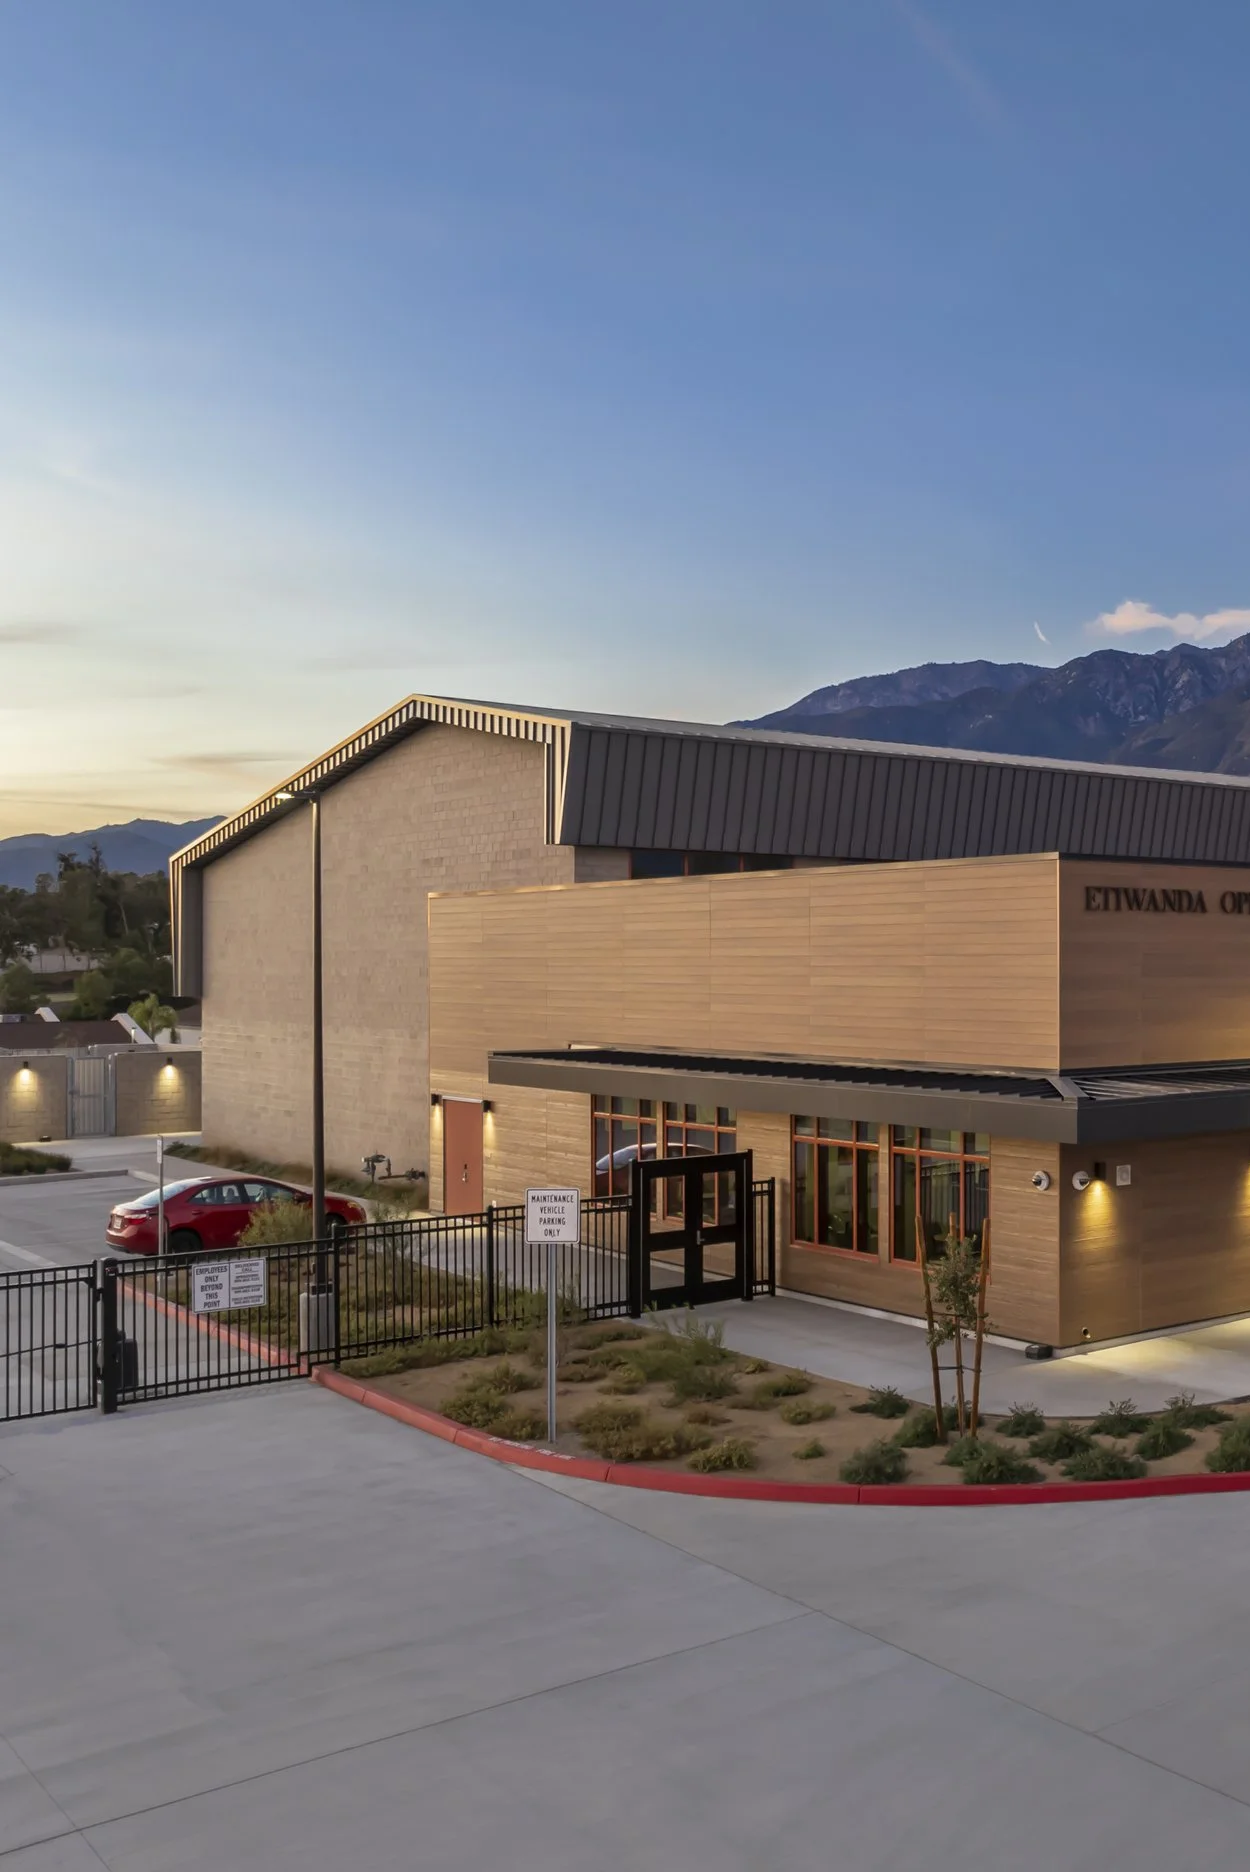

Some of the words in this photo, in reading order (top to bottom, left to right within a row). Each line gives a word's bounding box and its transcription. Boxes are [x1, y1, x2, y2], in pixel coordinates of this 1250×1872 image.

[1084, 886, 1207, 914] ETIWANDA
[531, 1195, 574, 1203] MAINTENANCE
[540, 1206, 565, 1214] VEHICLE
[544, 1229, 560, 1237] ONLY
[196, 1265, 228, 1275] EMPLOYEES
[205, 1275, 219, 1283] ONLY
[200, 1283, 223, 1292] BEYOND
[205, 1292, 218, 1300] THIS
[203, 1300, 220, 1308] POINT
